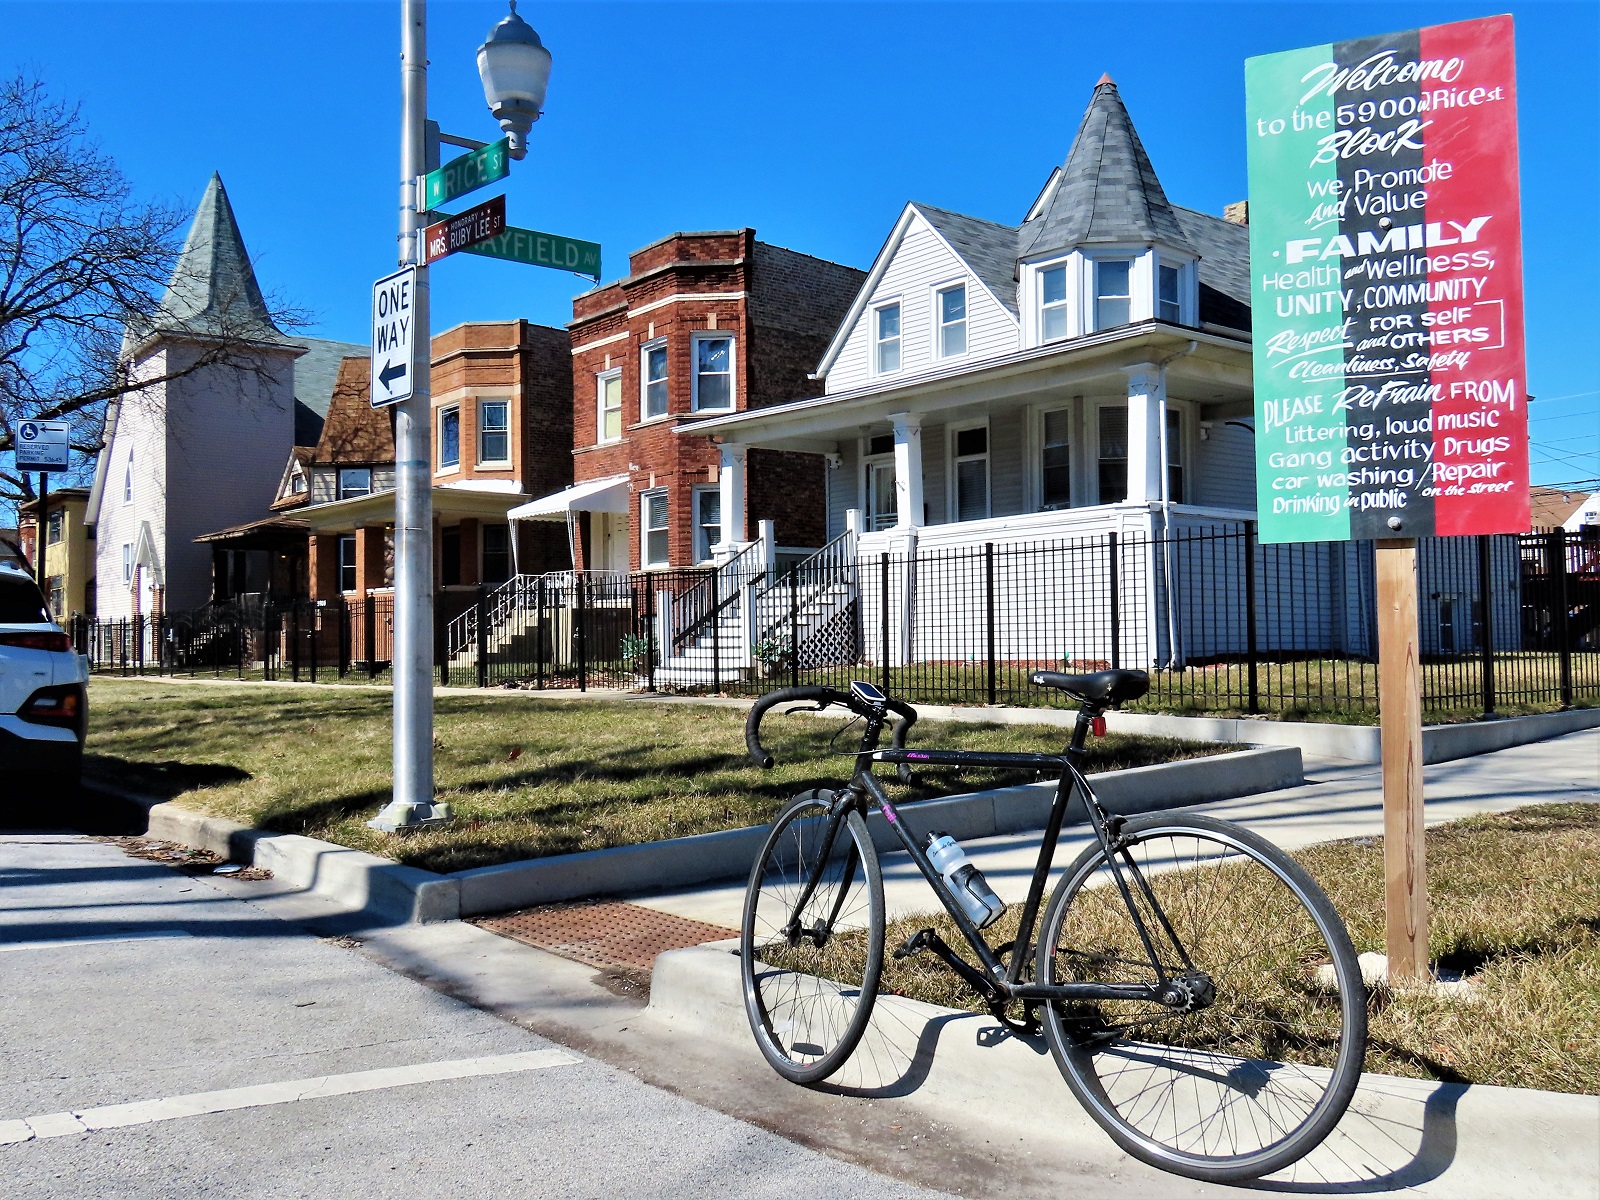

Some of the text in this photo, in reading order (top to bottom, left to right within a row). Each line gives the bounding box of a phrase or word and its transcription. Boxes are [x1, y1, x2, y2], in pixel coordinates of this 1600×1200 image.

[1300, 50, 1464, 105] Welcome
[1257, 116, 1286, 137] to
[1291, 104, 1332, 131] the
[1336, 96, 1416, 126] 5900
[1433, 87, 1486, 110] Rice
[433, 152, 504, 198] W RICE ST
[1354, 158, 1452, 193] Promote
[450, 212, 479, 231] HONORARY
[1354, 190, 1428, 216] Value
[430, 215, 501, 258] MRS. RUBY LEE ST
[473, 231, 598, 267] AYFIELD AV
[1285, 216, 1493, 266] FAMILY
[1262, 263, 1341, 292] Health
[1366, 251, 1495, 281] Wellness,
[378, 280, 409, 319] ONE
[377, 316, 410, 354] WAY
[1265, 316, 1358, 359] Respect
[1356, 327, 1490, 352] and OTHERS
[1399, 350, 1471, 373] Safety
[1263, 394, 1324, 434] PLEASE
[1451, 379, 1515, 411] FROM
[1285, 406, 1500, 445] Littering, loud music
[1268, 437, 1511, 470] Gang activity Drugs
[1271, 476, 1310, 490] car
[1342, 491, 1360, 508] in
[1360, 488, 1408, 513] public
[1421, 480, 1515, 497] on the street
